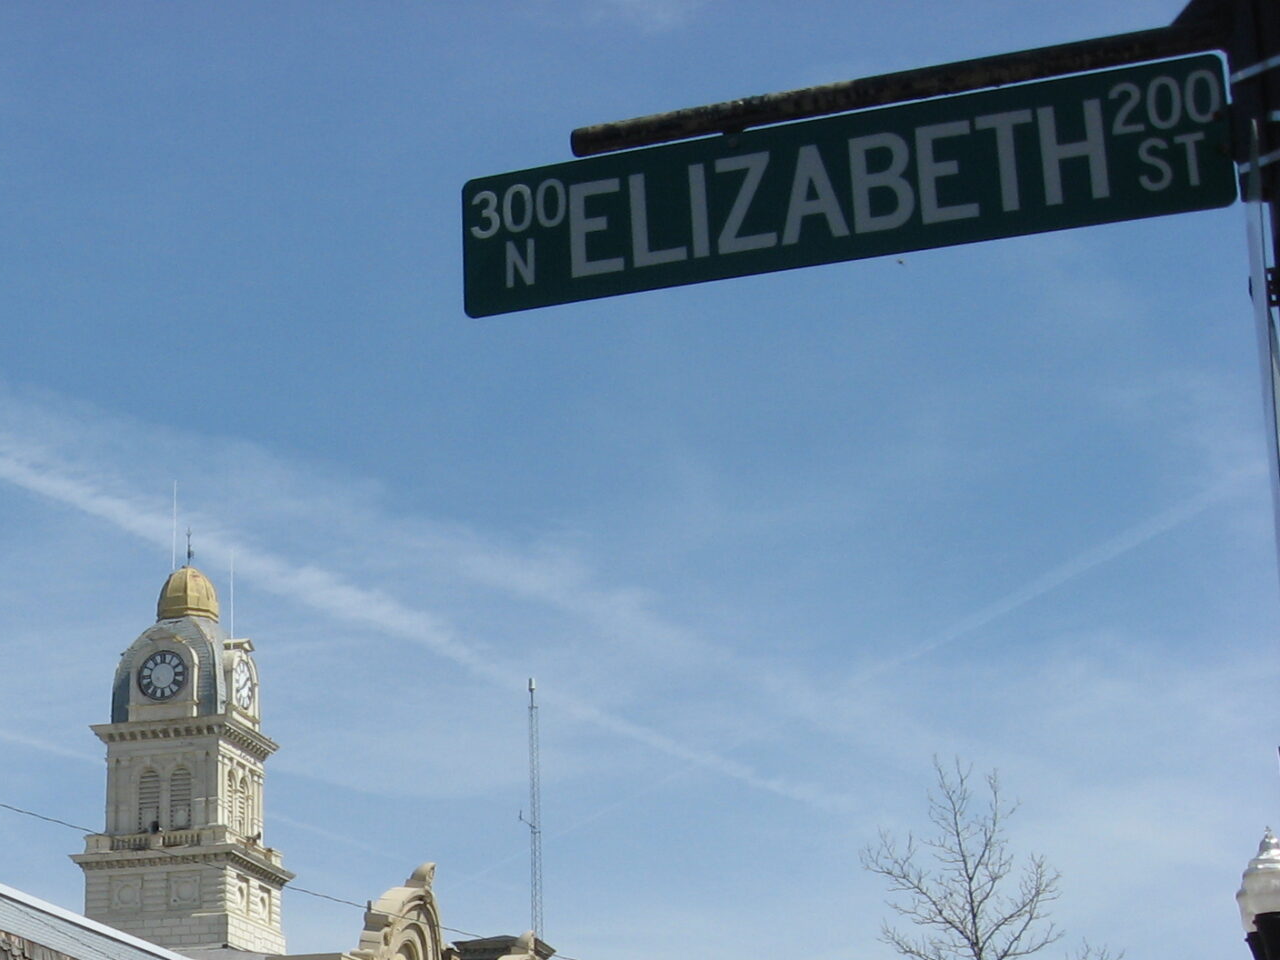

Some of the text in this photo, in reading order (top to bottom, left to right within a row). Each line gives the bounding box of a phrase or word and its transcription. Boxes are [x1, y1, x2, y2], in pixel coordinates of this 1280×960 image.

[1111, 68, 1220, 136] 200
[470, 177, 566, 240] 300
[504, 98, 1207, 289] N ELIZABETH ST
